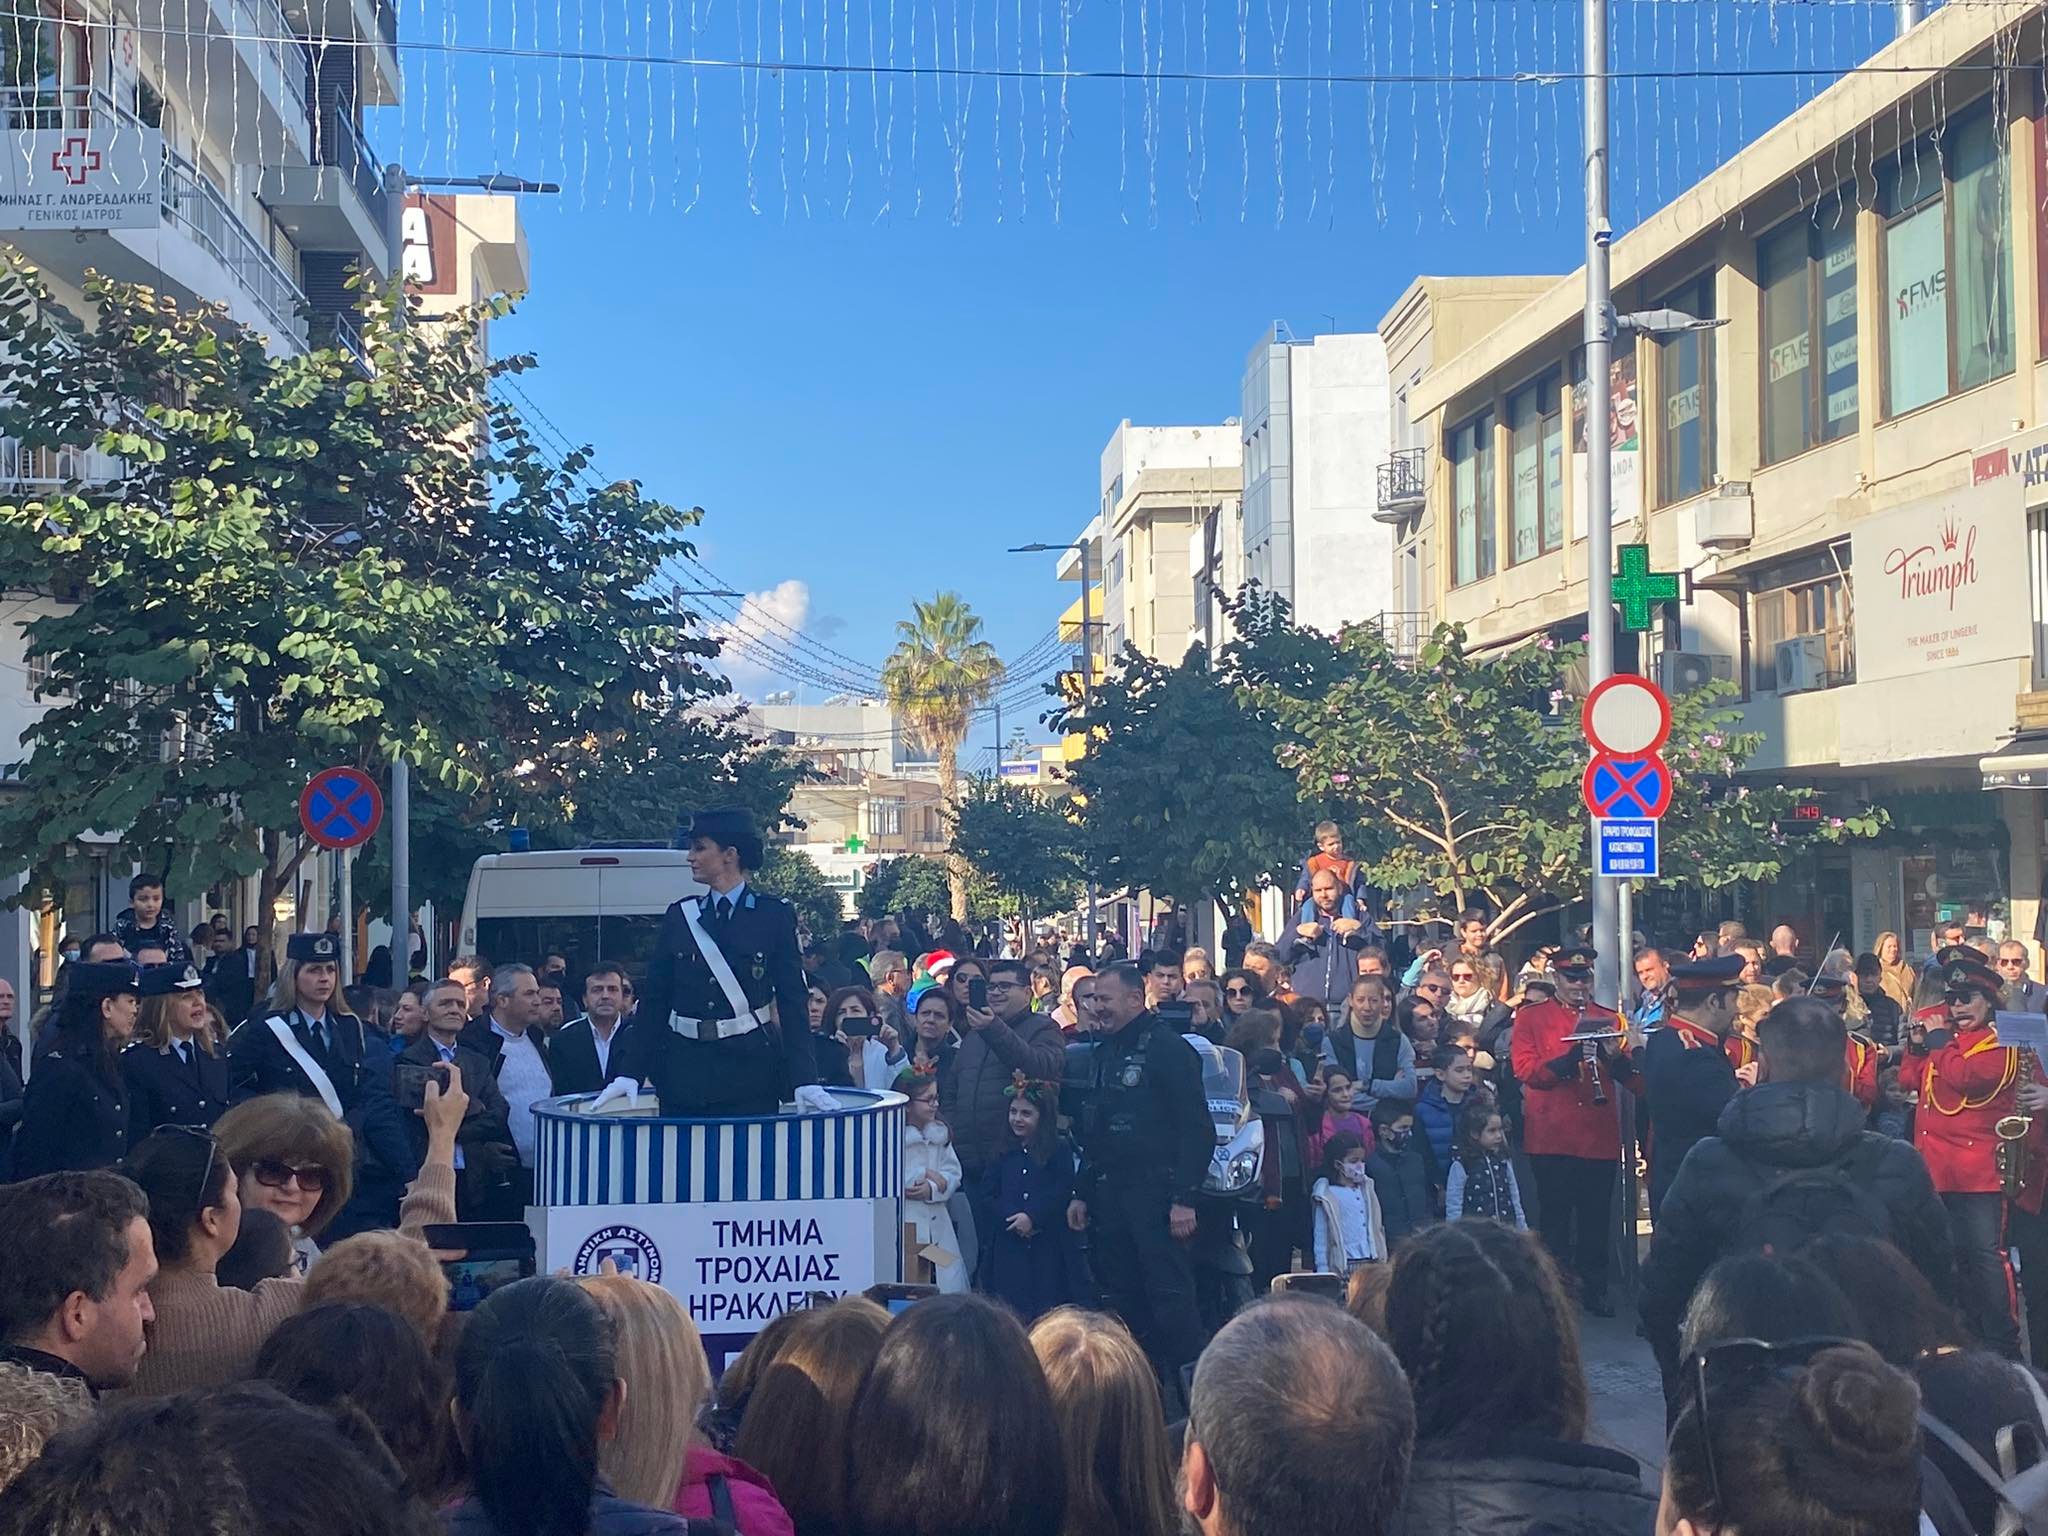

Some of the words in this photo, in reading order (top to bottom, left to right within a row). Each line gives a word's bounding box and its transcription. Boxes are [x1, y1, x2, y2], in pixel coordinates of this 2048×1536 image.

[60, 192, 153, 205] ΑΝΔΡΕΑΔΑΚΗΣ
[28, 209, 78, 221] ΓΕΝΙΚΟΣ
[82, 208, 123, 221] ΙΑΤΡΟΣ
[1884, 525, 1979, 611] Triumph
[1907, 637, 1919, 648] THE
[1920, 632, 1940, 645] MAKER
[1941, 630, 1949, 641] OF
[1926, 649, 1945, 661] SINCE
[712, 1218, 823, 1248] ΤΜΗΜΑ
[696, 1254, 841, 1285] ΤΡΟΧΑΙΑΣ
